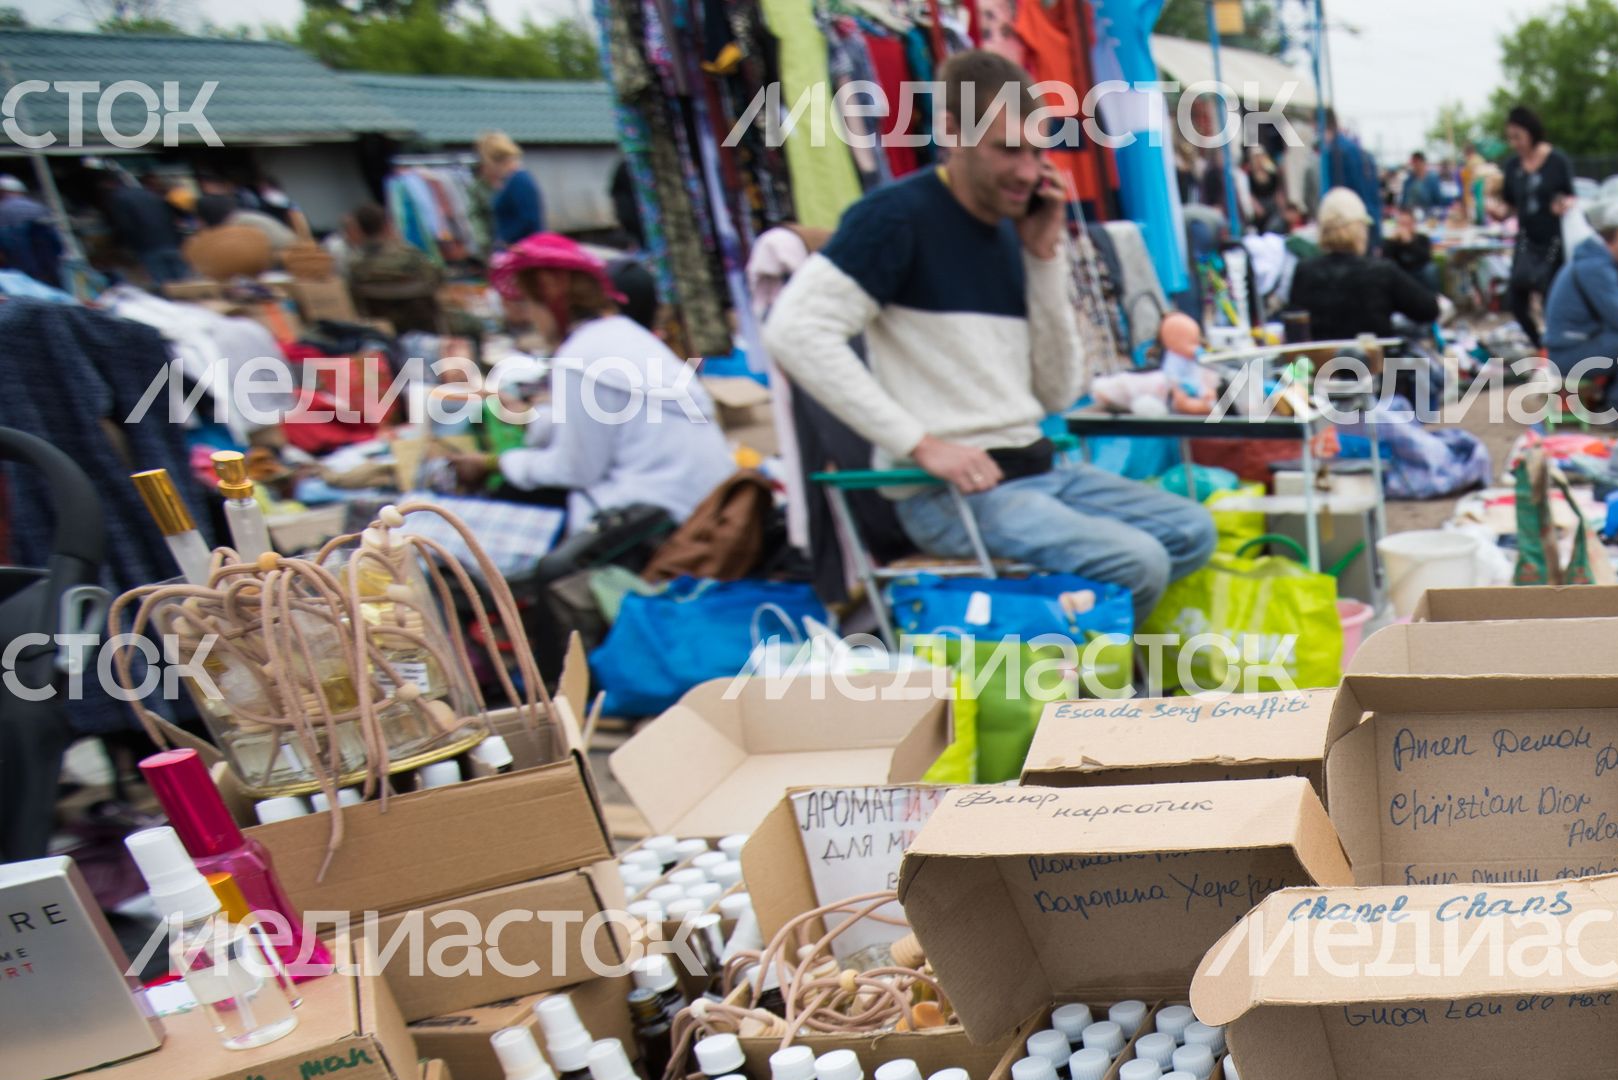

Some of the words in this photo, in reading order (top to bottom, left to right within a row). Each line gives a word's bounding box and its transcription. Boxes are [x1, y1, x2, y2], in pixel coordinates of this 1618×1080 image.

[1055, 702, 1144, 720] Escada
[1150, 702, 1203, 722] Sexy
[1211, 694, 1313, 721] Graffiti
[1052, 799, 1213, 822] наркотик
[1389, 786, 1529, 830] Christian
[1538, 785, 1592, 816] Dior
[821, 834, 874, 866] ДЛЯ
